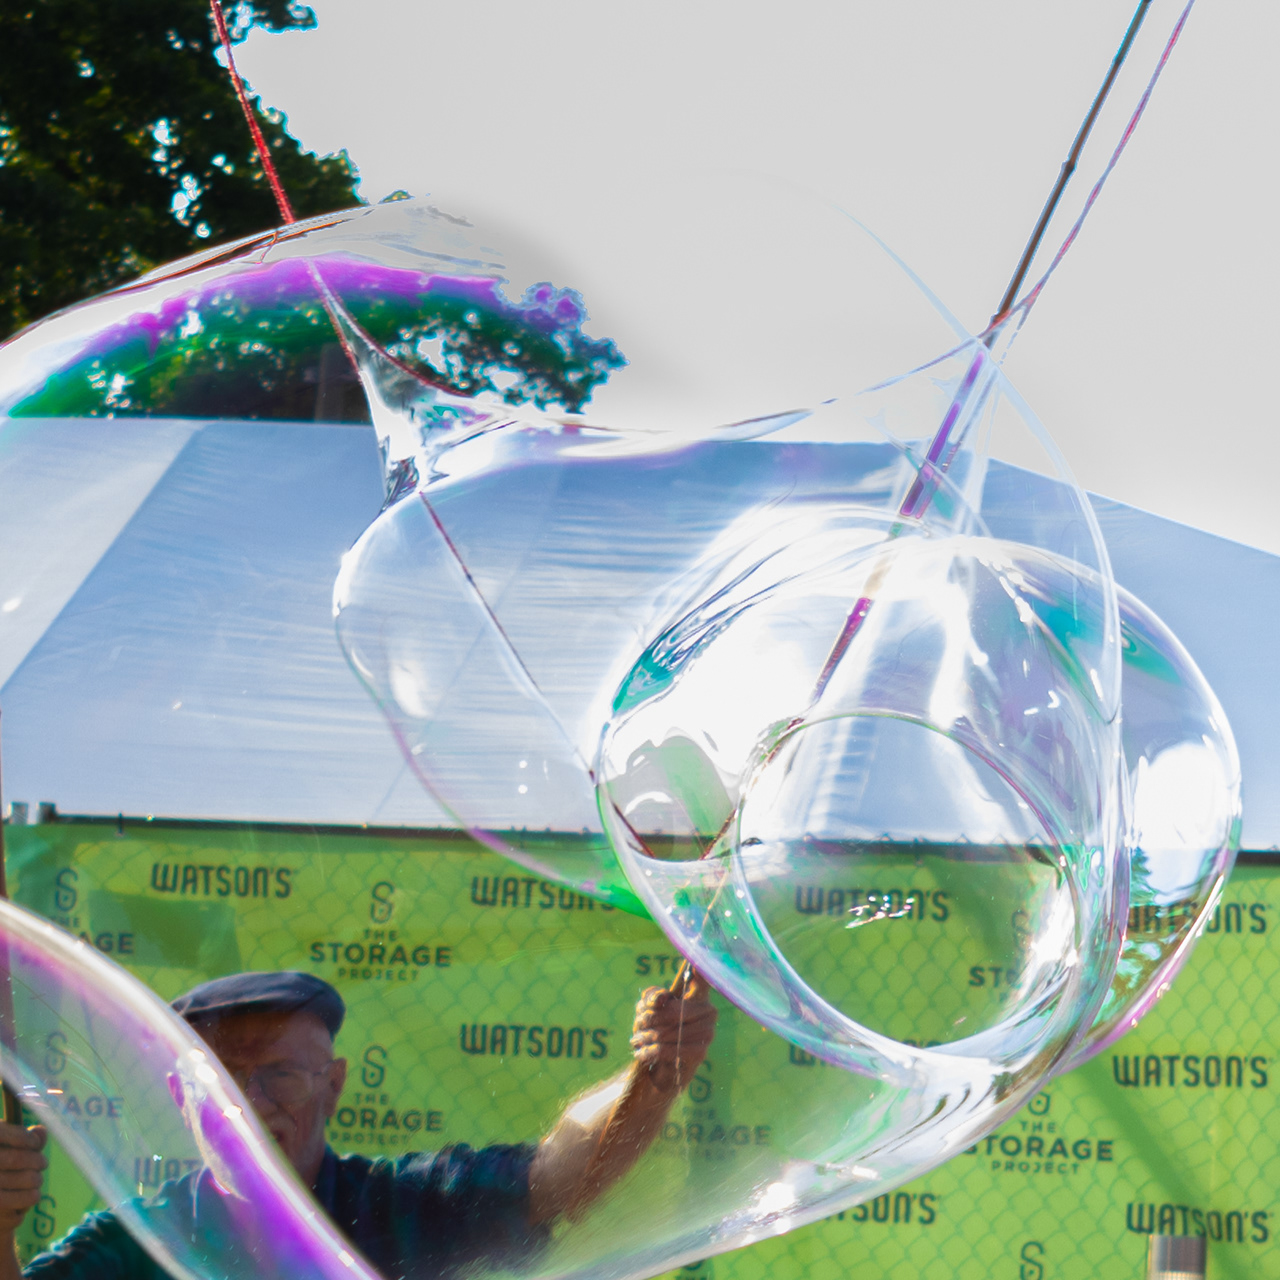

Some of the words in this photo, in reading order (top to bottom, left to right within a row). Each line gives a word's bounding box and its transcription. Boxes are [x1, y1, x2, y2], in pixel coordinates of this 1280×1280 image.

[152, 863, 291, 898] WATSON'S
[310, 942, 451, 967] STORAGE
[461, 1024, 608, 1059] WATSON'S
[1114, 1054, 1268, 1088] WATSON'S
